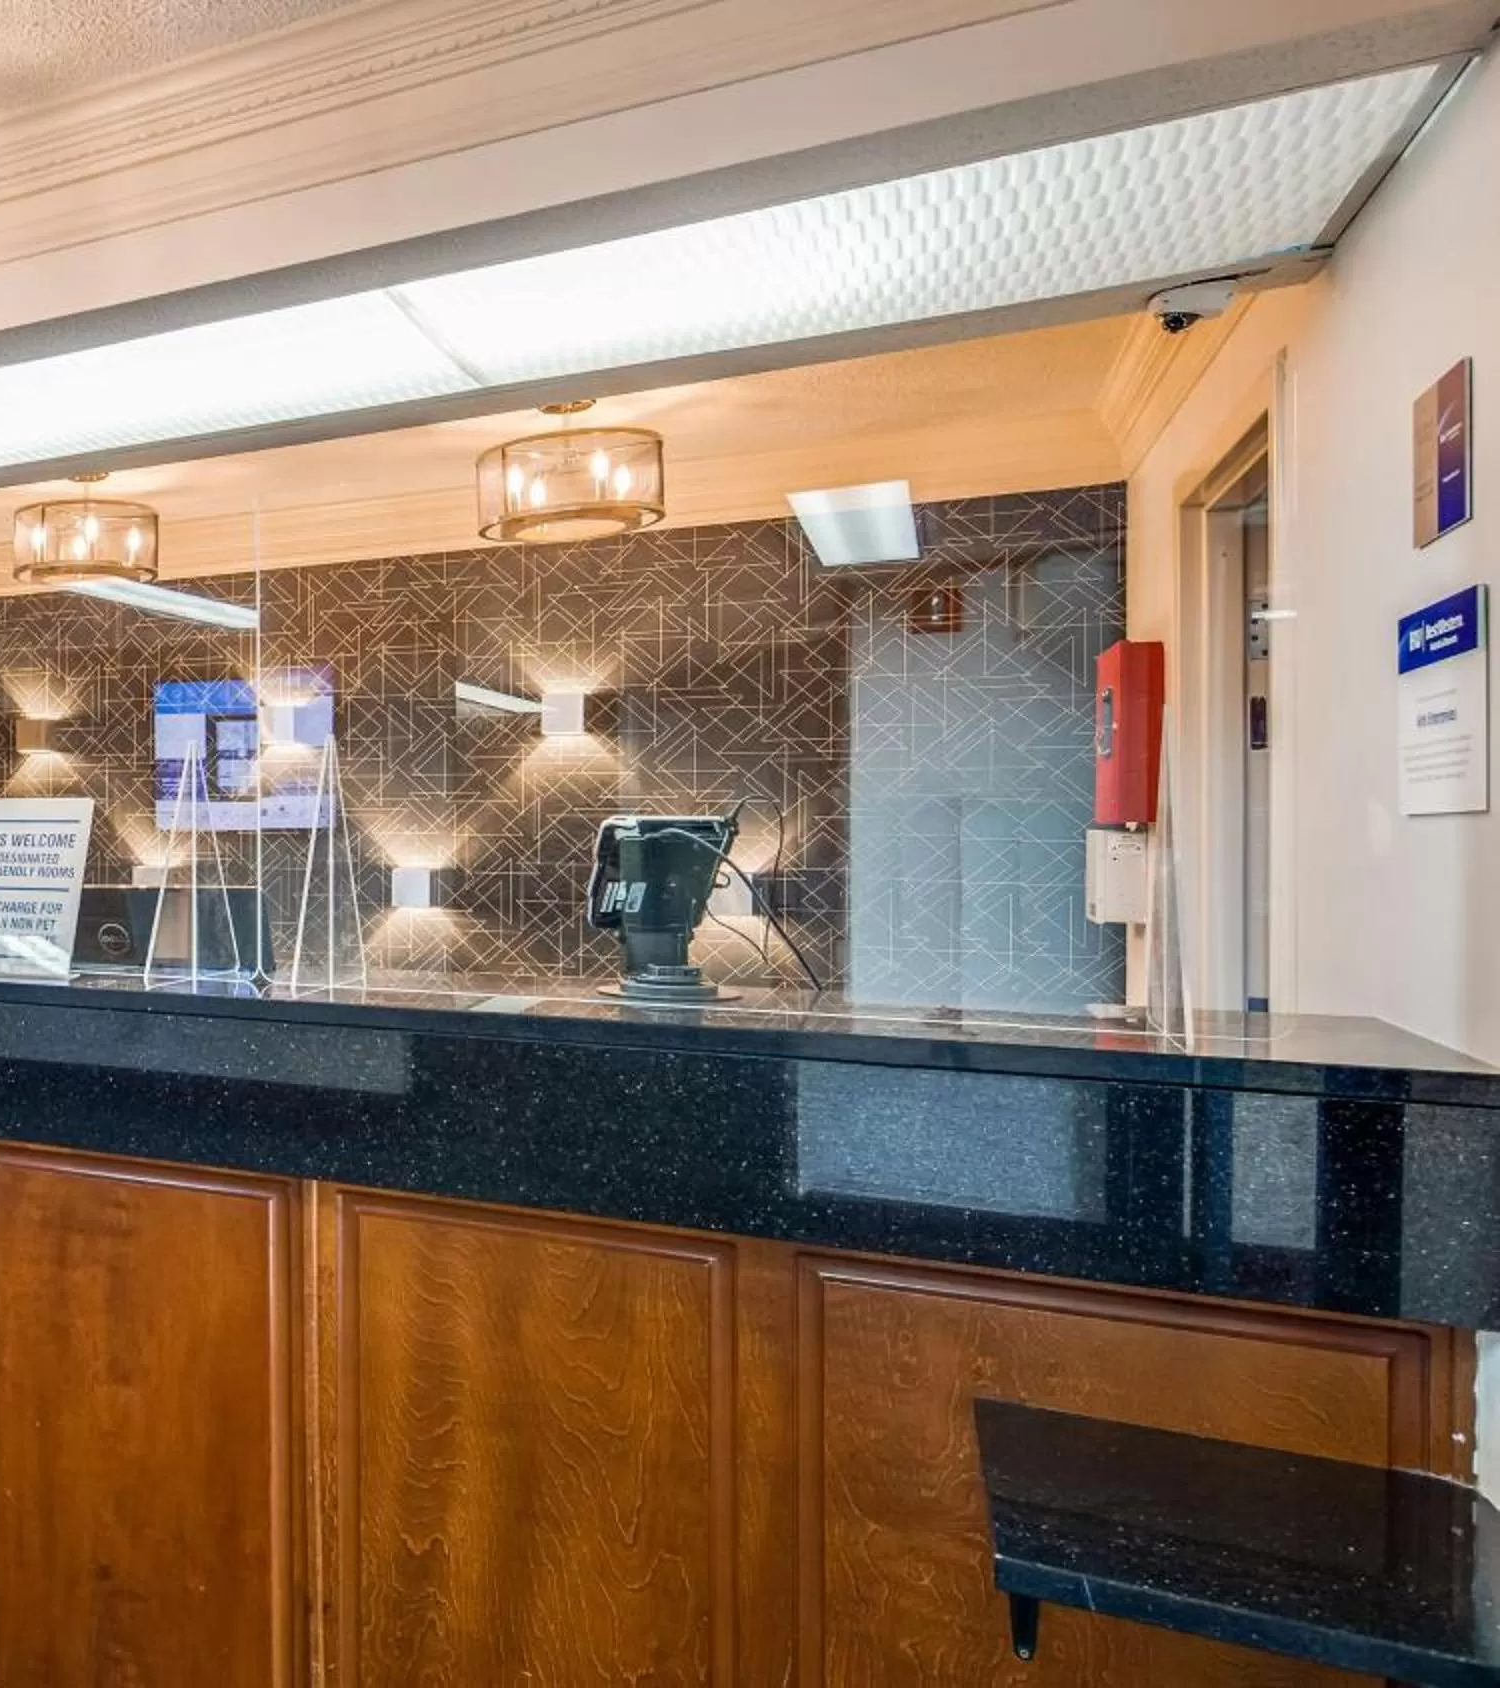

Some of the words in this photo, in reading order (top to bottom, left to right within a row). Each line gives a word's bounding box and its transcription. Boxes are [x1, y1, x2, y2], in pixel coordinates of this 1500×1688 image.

[11, 833, 77, 849] WELCOME
[37, 866, 76, 879] ROOMS
[40, 902, 64, 915] FOR
[9, 917, 34, 929] NON
[36, 918, 56, 932] PET
